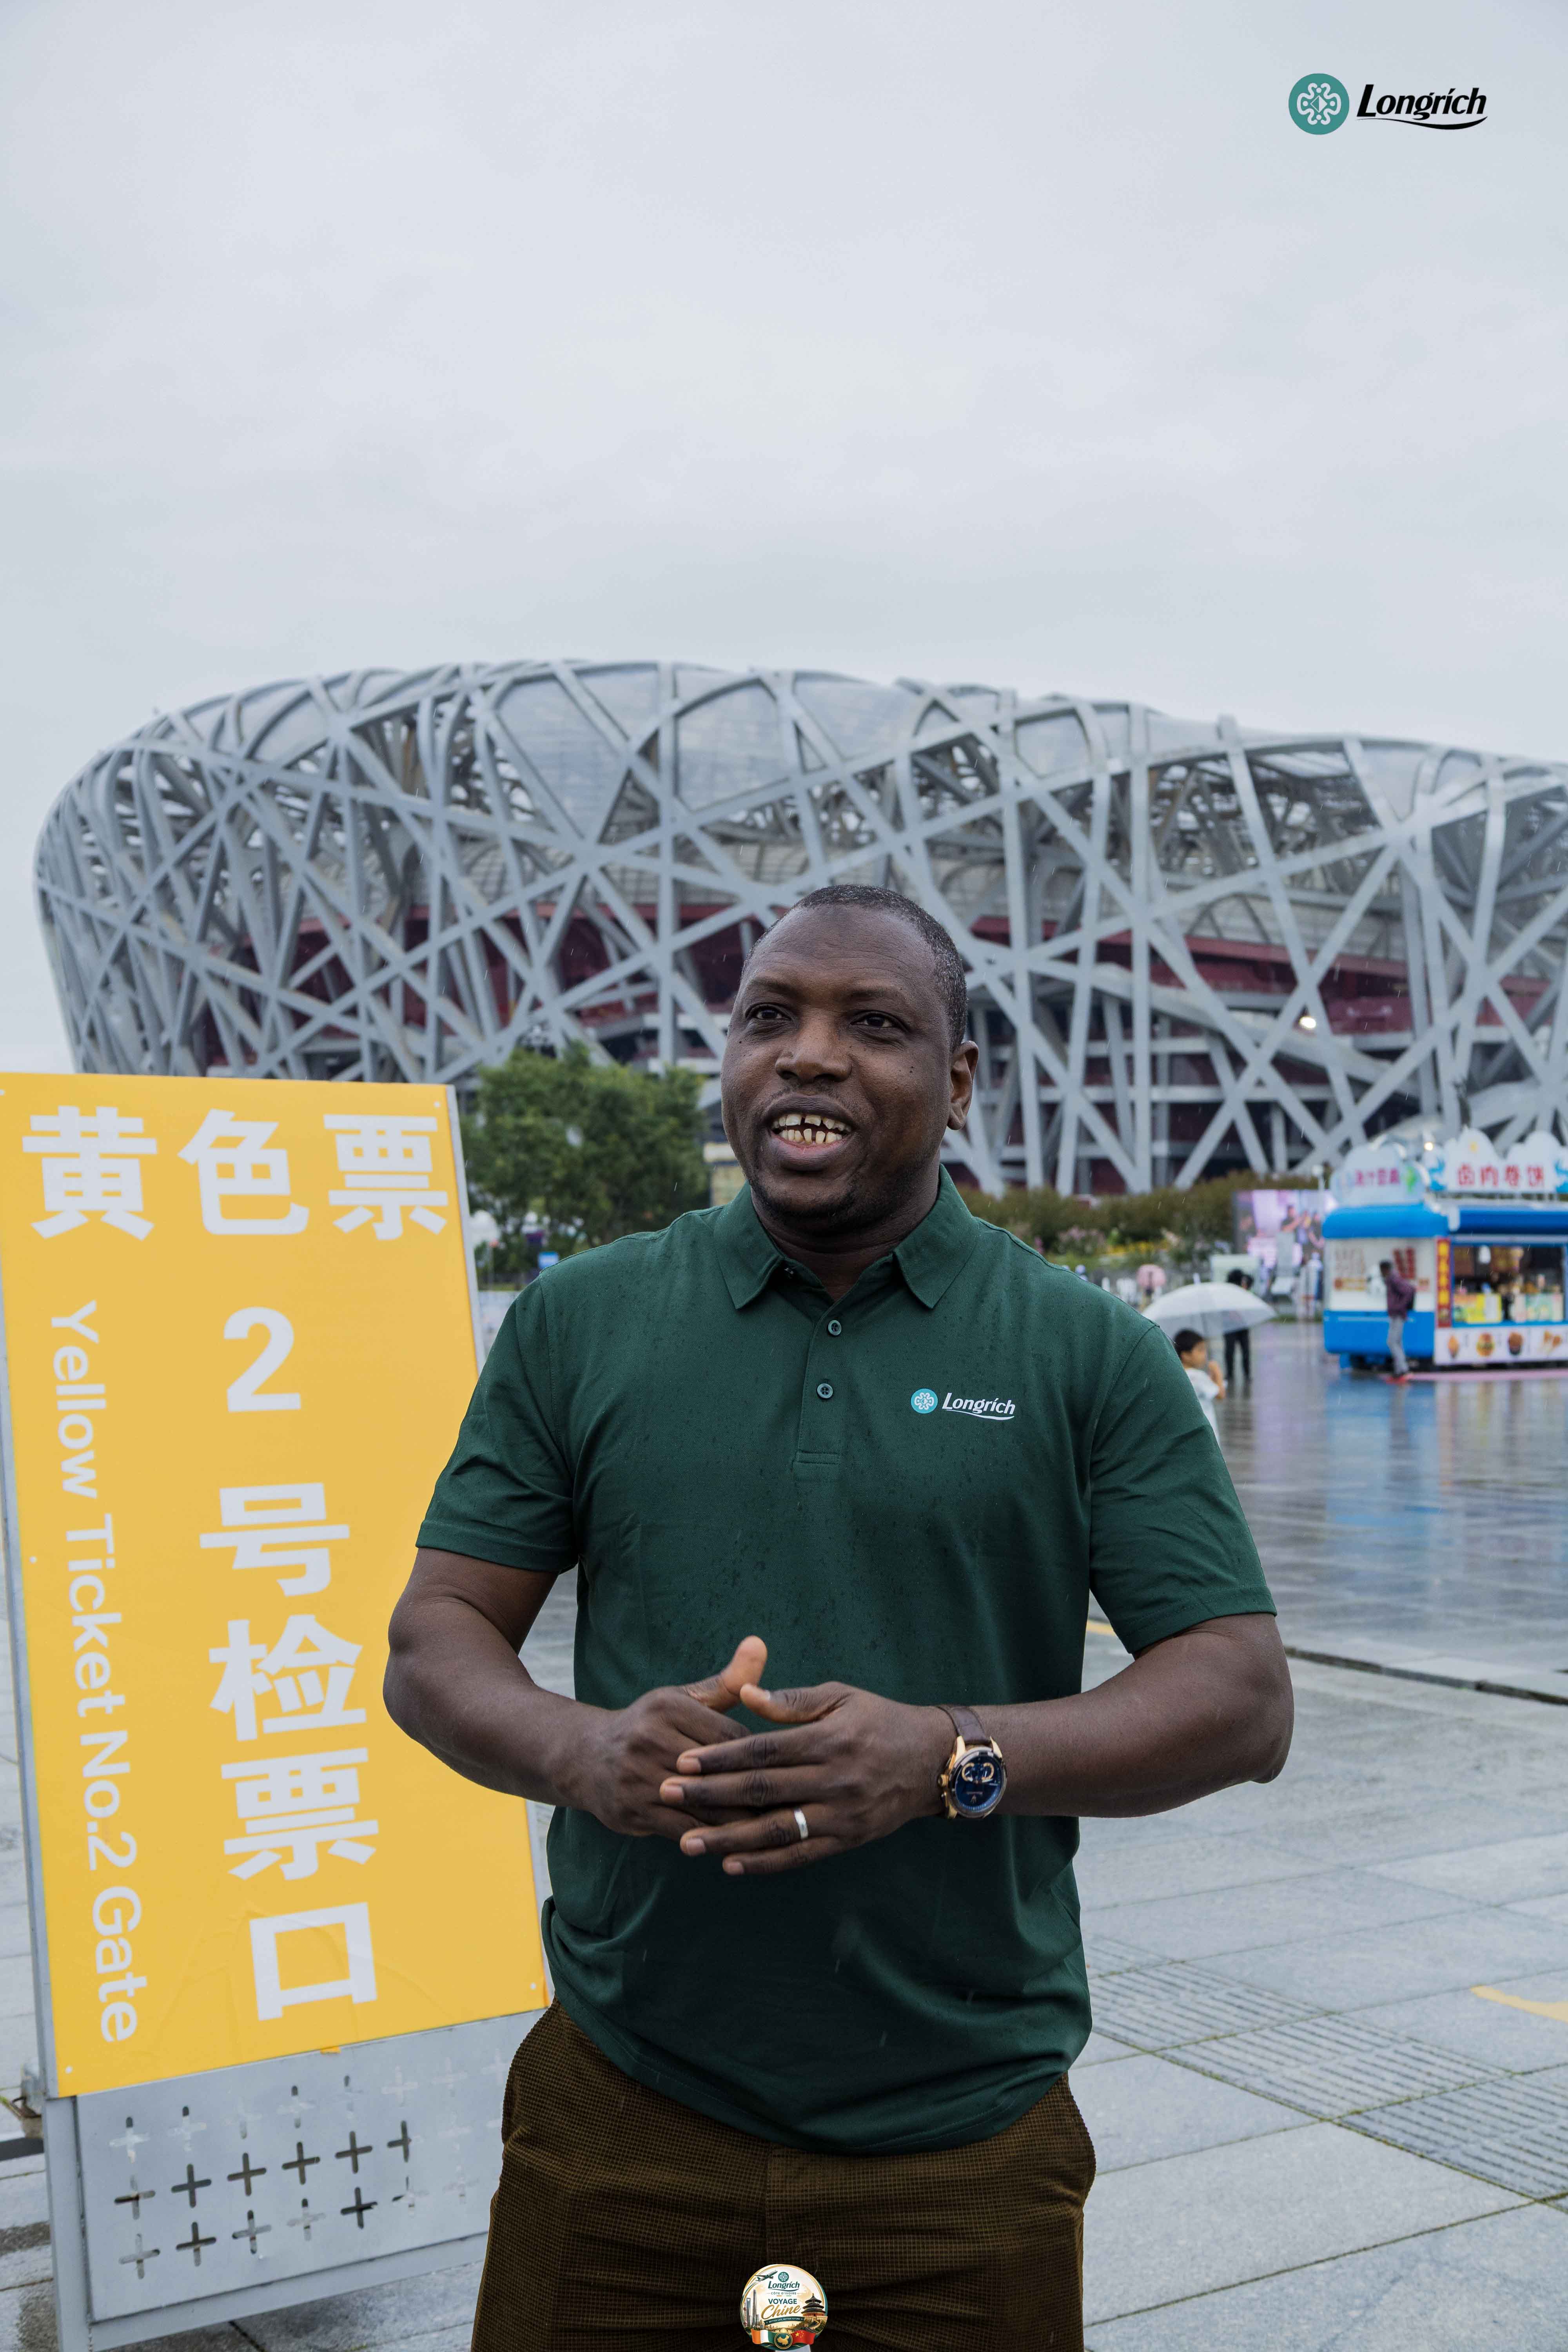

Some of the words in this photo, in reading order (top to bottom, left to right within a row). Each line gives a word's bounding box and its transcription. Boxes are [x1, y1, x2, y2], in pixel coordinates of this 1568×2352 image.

[22, 1105, 448, 1240] 黄色票
[51, 1300, 107, 1499] Yellow
[942, 1392, 1016, 1415] Longrich
[65, 1513, 125, 1717] Ticket
[80, 1731, 137, 1871] No.2
[92, 1886, 147, 2042] Gate
